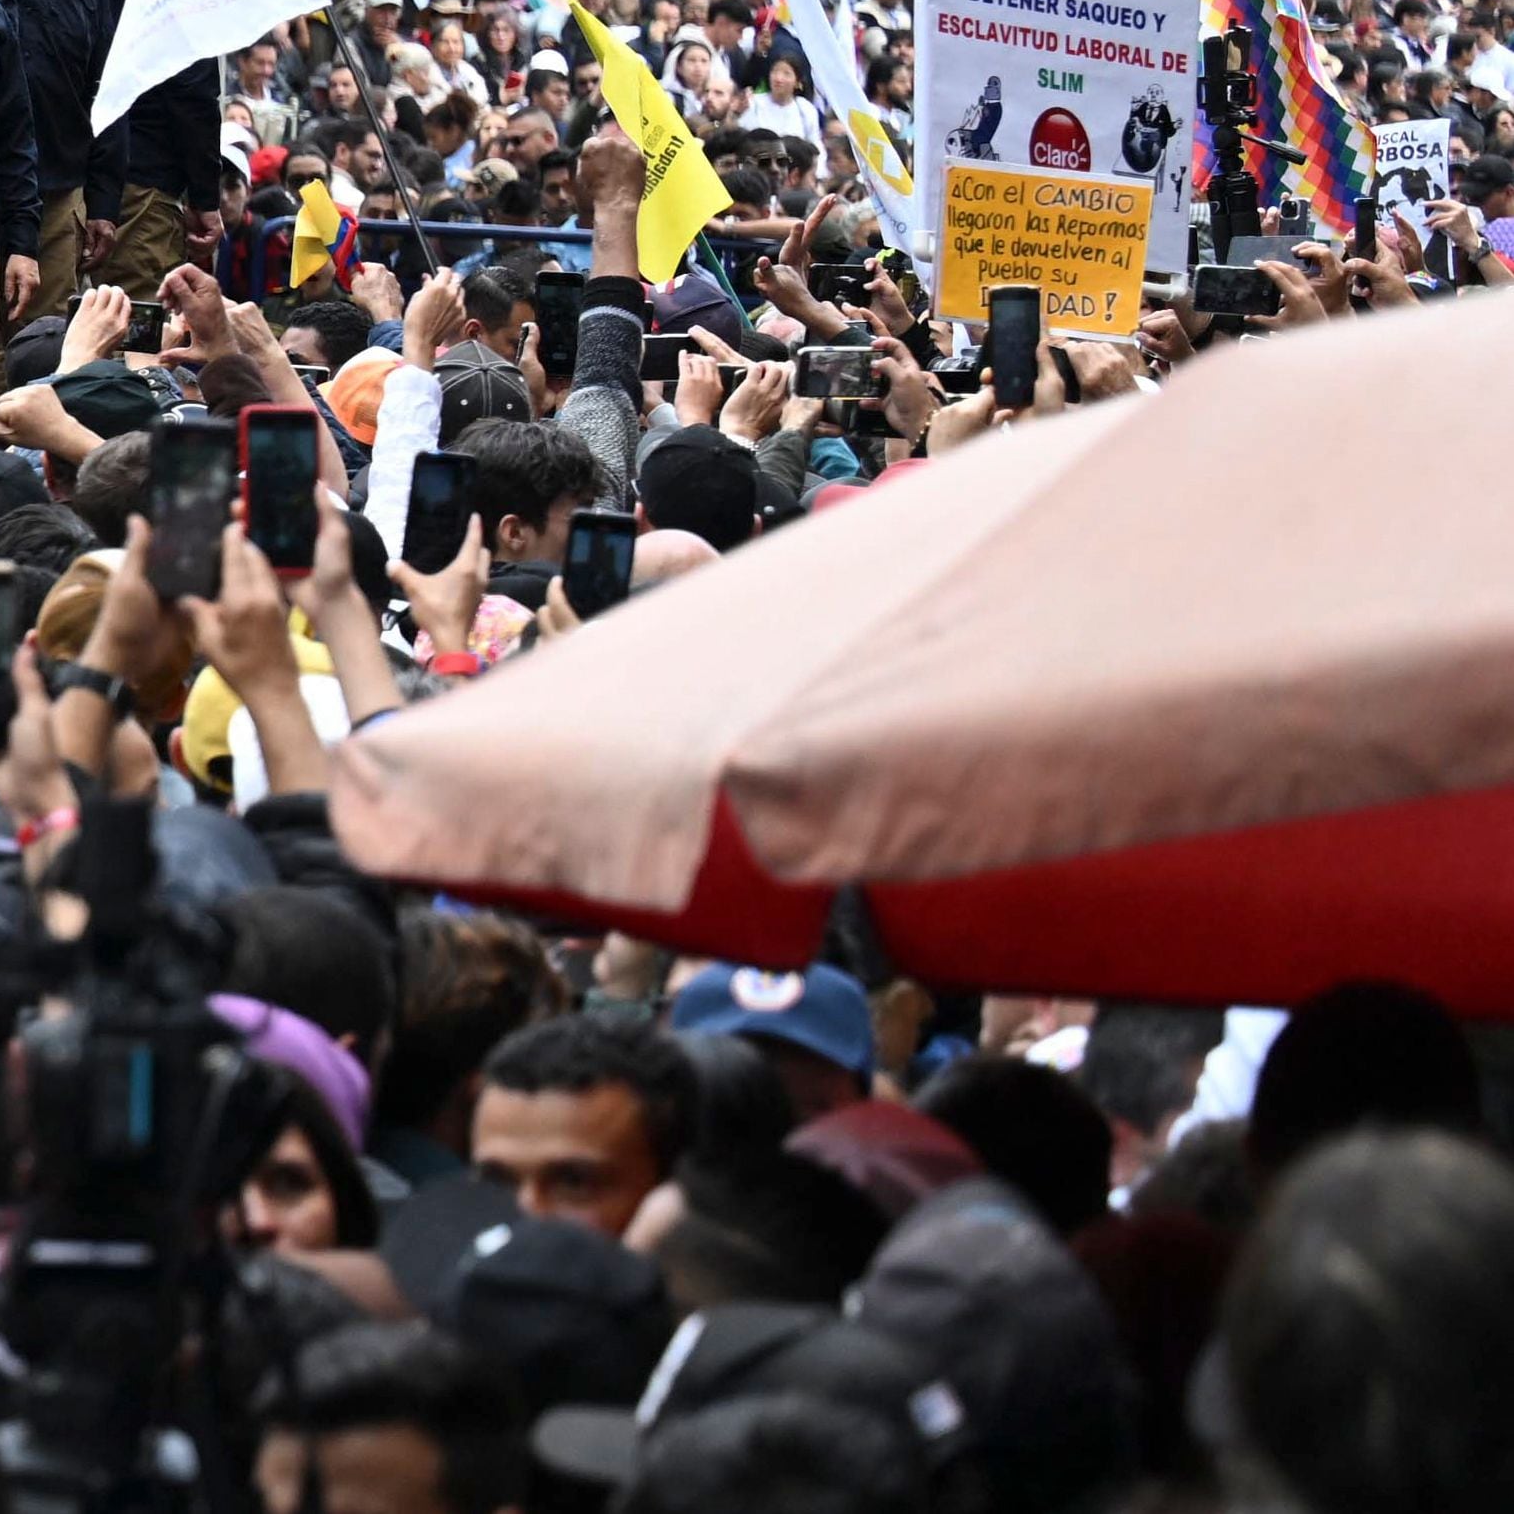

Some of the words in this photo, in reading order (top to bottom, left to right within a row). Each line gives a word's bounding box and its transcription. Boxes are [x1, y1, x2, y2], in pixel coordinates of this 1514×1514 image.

[1154, 12, 1167, 33] Y
[938, 12, 1058, 52] ESCLAVITUD
[1065, 35, 1155, 69] LABORAL
[1161, 51, 1188, 74] DE
[1037, 68, 1084, 93] SLIM
[1377, 130, 1419, 145] ISCAL
[1034, 143, 1079, 169] Claro
[1376, 142, 1443, 162] RBOSA
[1003, 181, 1025, 205] el
[948, 204, 1015, 236] llegaron
[1025, 210, 1050, 234] las
[1056, 214, 1147, 242] Reformas
[954, 236, 985, 261] que
[991, 234, 1005, 256] le
[1011, 236, 1106, 265] devuelven
[1111, 247, 1133, 271] al
[1050, 268, 1079, 286] su
